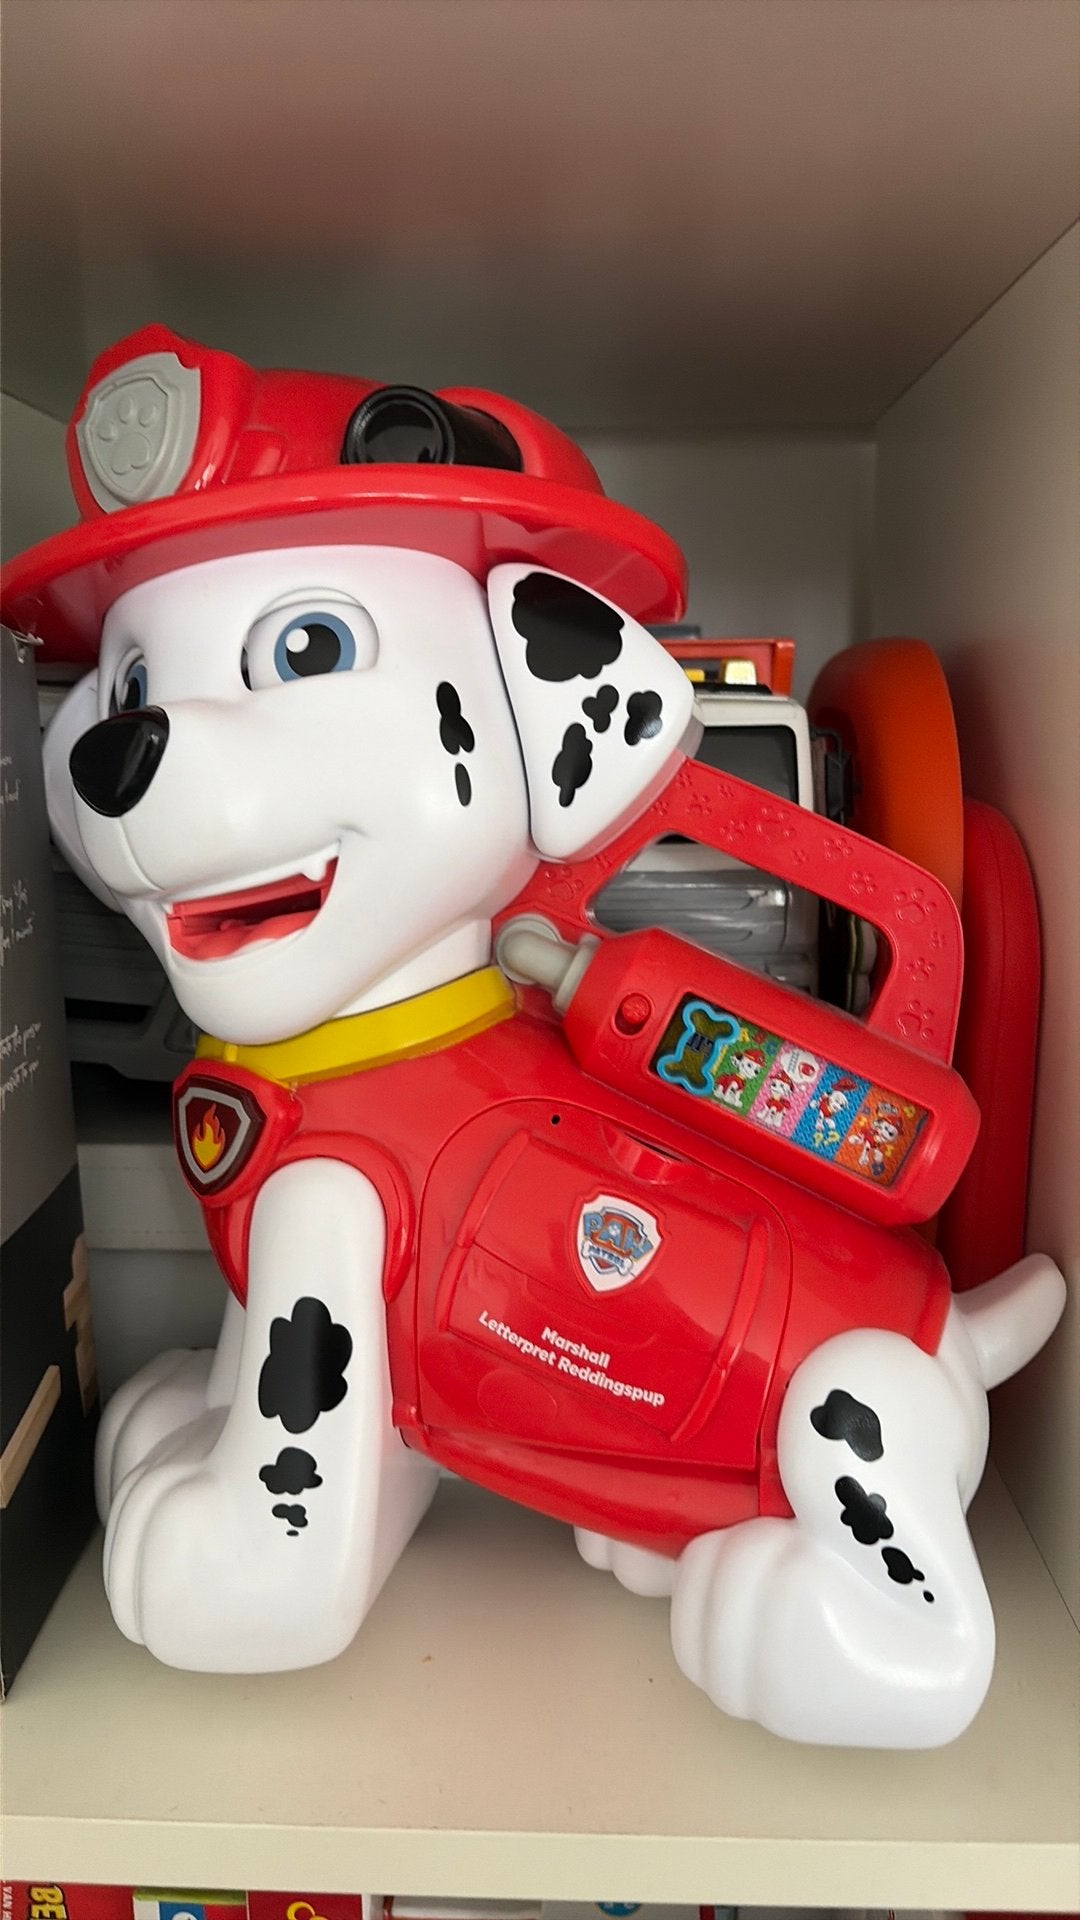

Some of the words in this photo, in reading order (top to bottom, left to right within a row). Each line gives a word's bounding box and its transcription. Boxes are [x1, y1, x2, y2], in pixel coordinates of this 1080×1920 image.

[583, 1212, 653, 1259] PAW
[588, 1246, 625, 1268] PATROL
[479, 1310, 556, 1365] Letterpret
[557, 1356, 665, 1407] Reddingspup
[541, 1326, 611, 1368] Marshall
